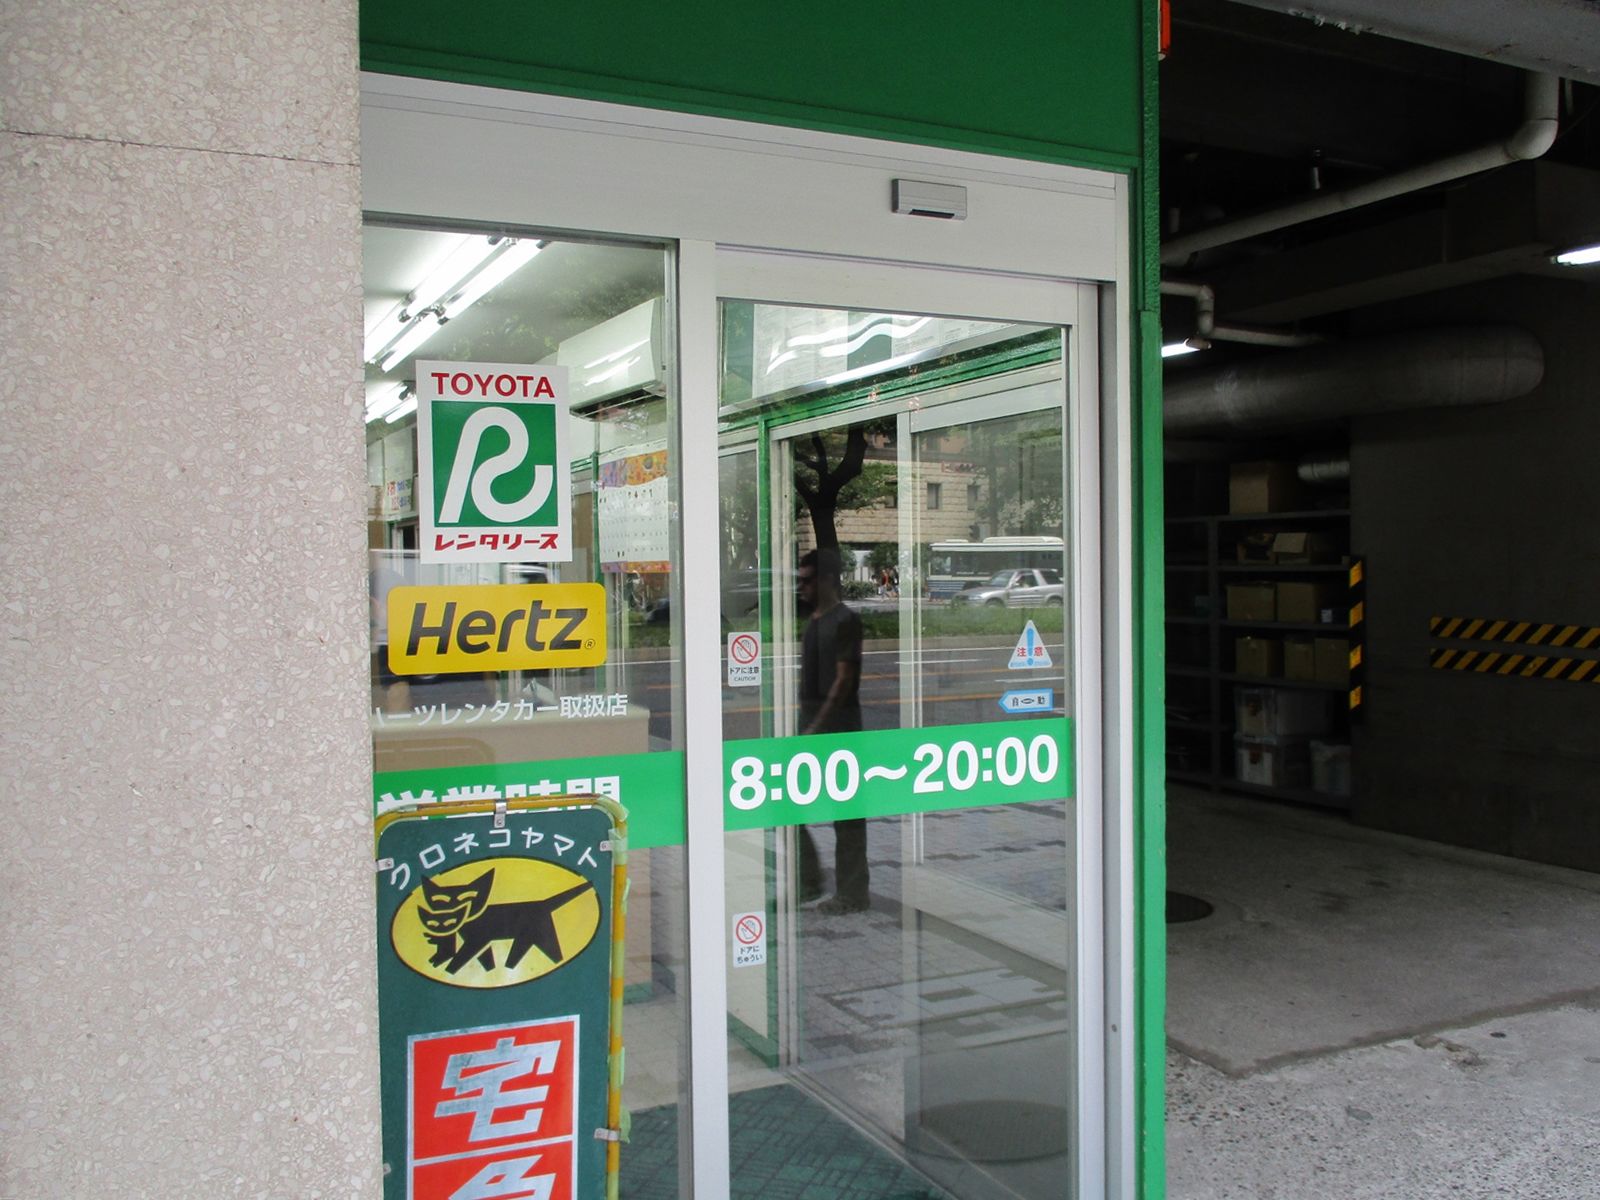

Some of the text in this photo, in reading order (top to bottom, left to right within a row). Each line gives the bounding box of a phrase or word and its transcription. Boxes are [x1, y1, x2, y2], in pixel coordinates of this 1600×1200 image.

[431, 372, 555, 398] TOYOTA
[434, 533, 559, 551] レンタリース
[405, 600, 588, 656] Hertz
[390, 826, 597, 890] クロネコヤマト
